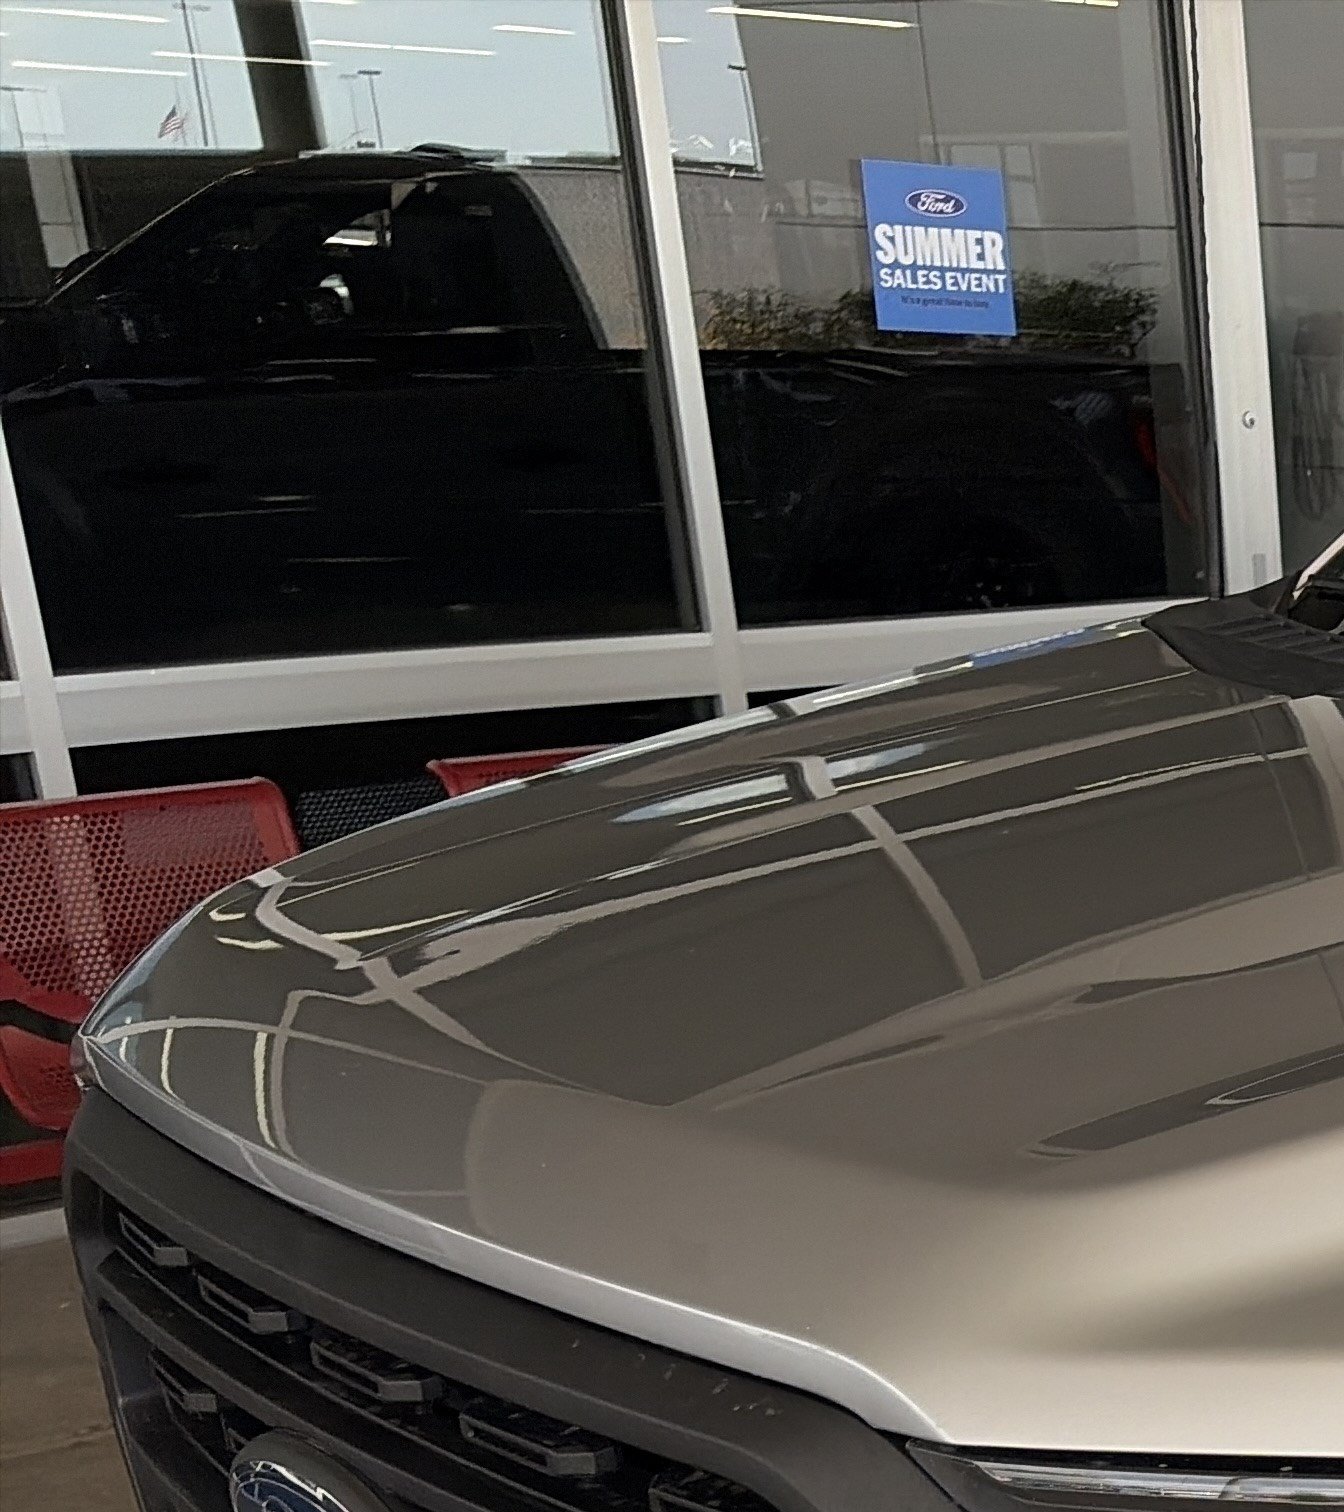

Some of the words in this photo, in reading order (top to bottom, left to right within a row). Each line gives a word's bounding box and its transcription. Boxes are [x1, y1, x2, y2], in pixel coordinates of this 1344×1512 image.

[917, 193, 957, 213] Ford
[874, 223, 1006, 270] SUMMER
[879, 267, 942, 291] SALES
[945, 271, 1007, 293] EVENT
